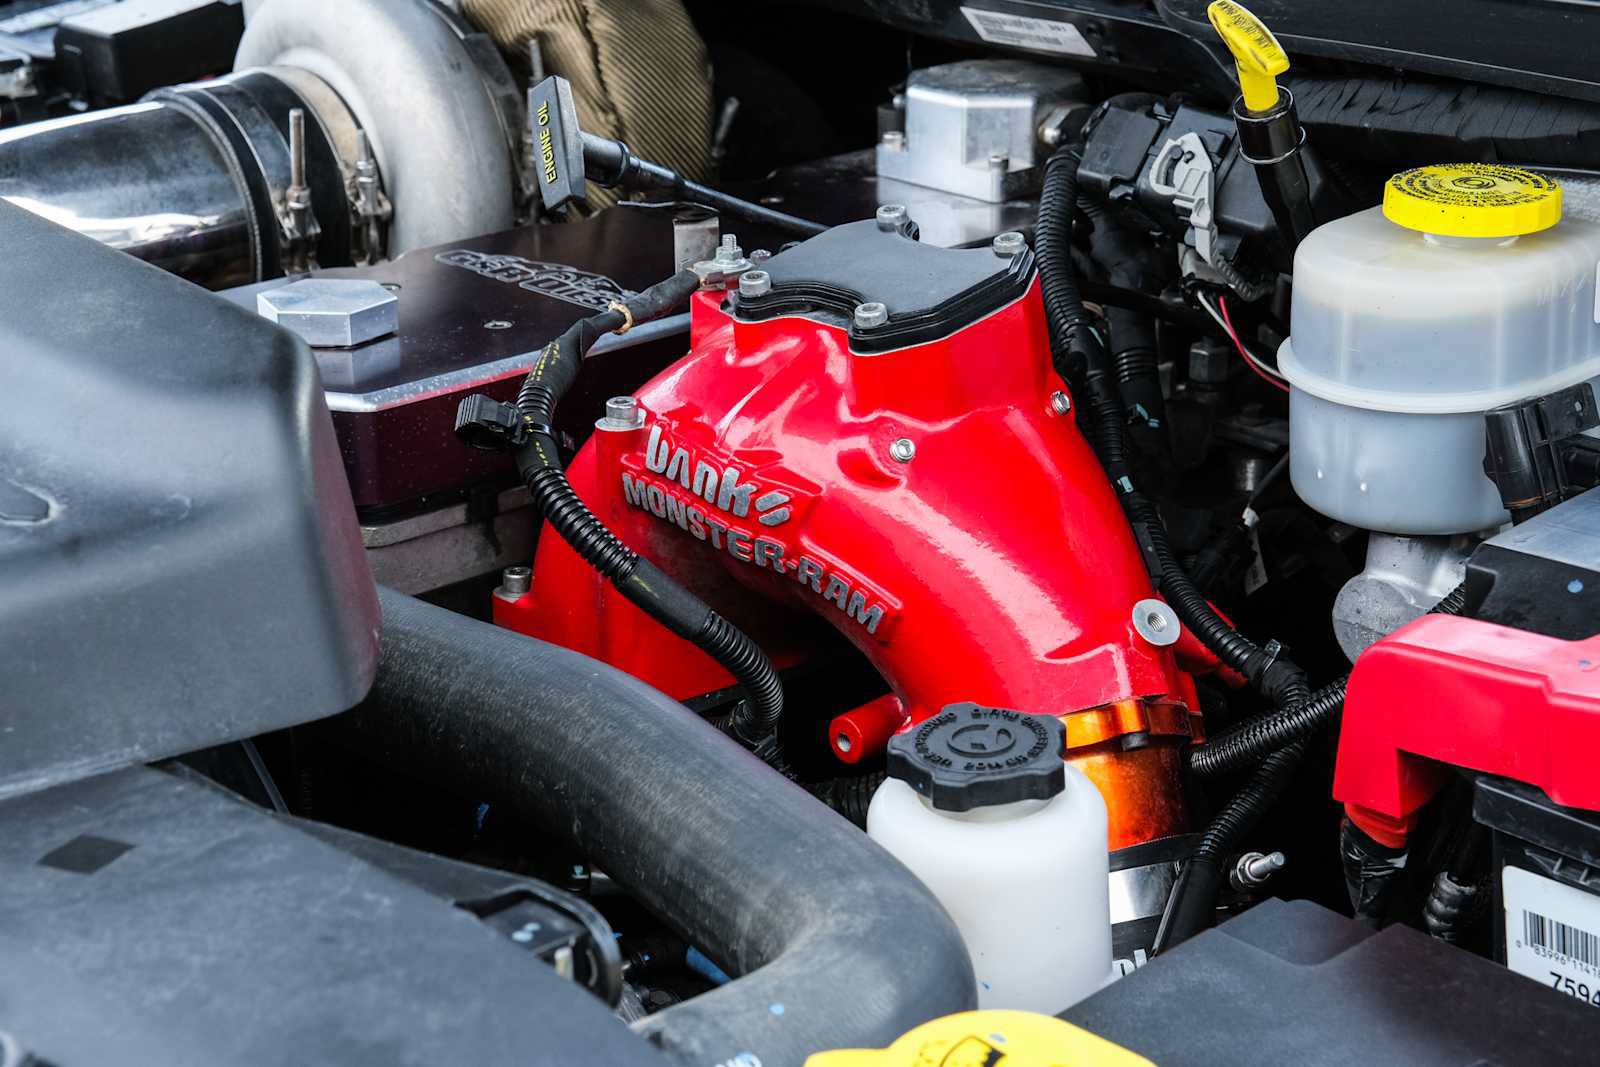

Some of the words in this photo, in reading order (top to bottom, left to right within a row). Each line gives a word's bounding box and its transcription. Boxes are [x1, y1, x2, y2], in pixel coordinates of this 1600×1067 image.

[537, 100, 550, 126] OIL
[539, 127, 558, 184] ENGINE
[621, 472, 884, 635] MONSTER-RAM
[1533, 943, 1567, 966] 83996
